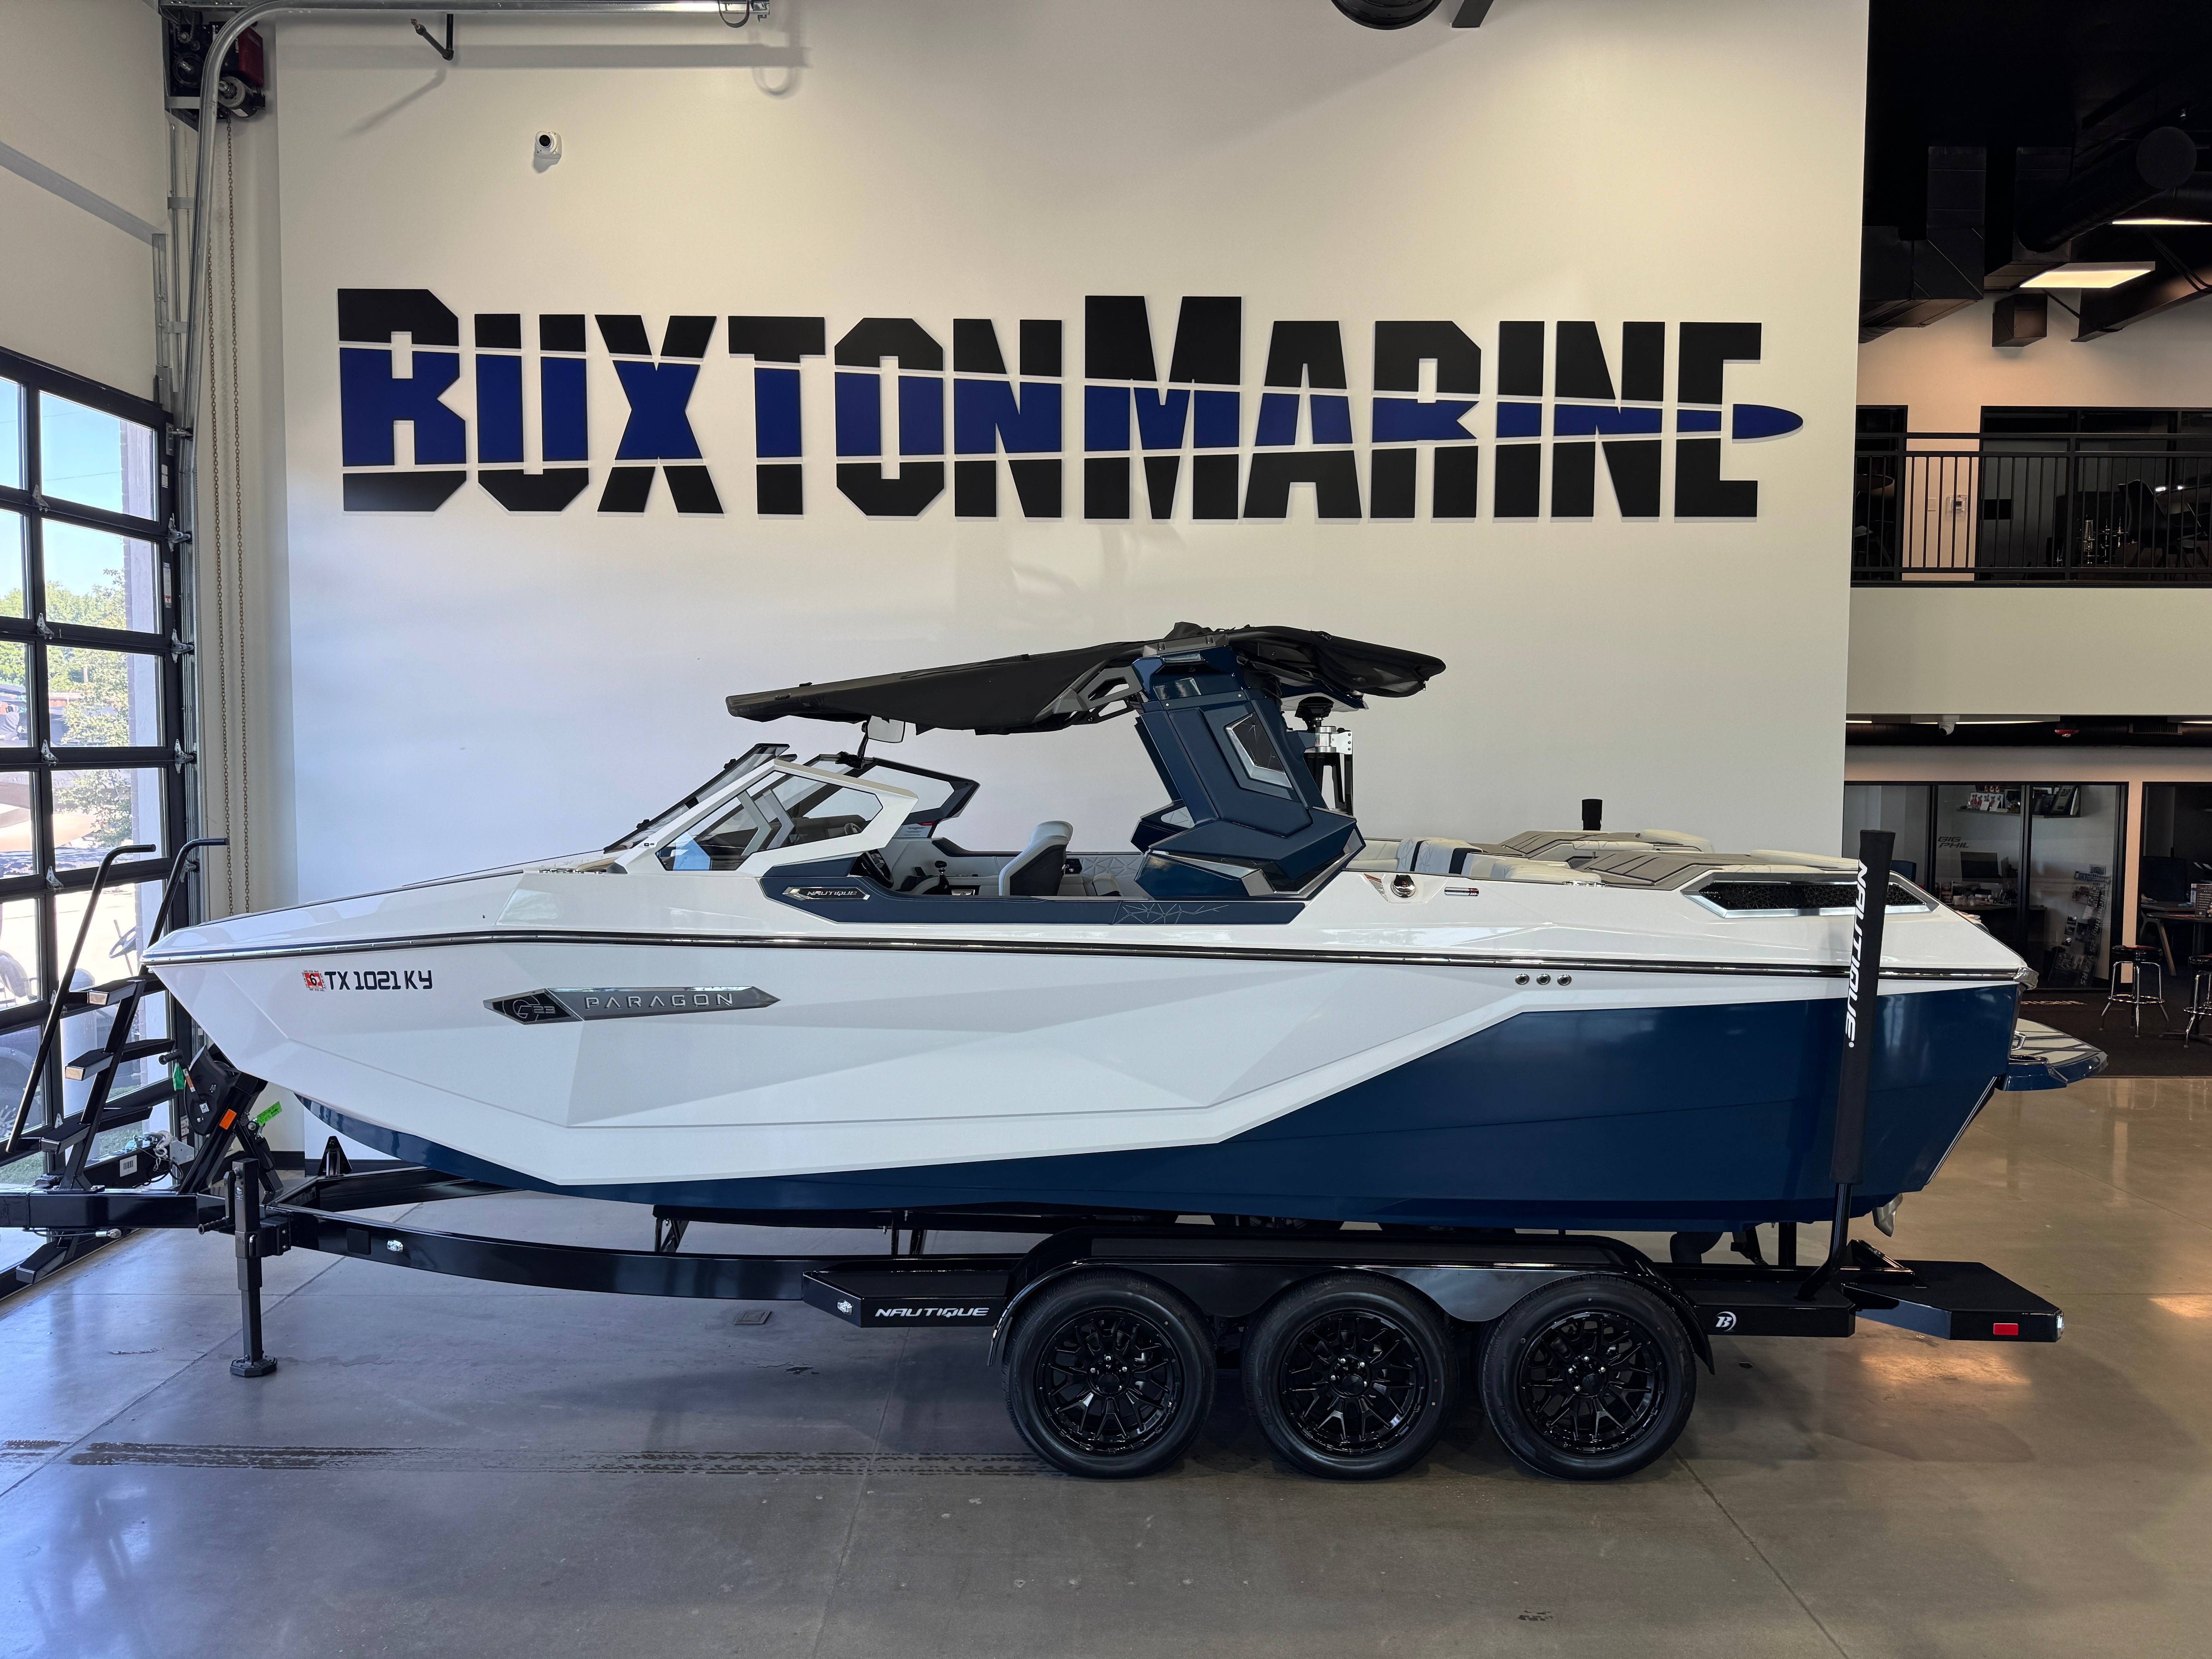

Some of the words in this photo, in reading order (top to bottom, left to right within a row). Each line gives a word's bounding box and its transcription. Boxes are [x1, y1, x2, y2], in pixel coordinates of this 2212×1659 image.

[309, 973, 317, 986] 6
[324, 971, 350, 990] TX
[353, 971, 401, 990] 1021
[404, 970, 433, 989] KY
[585, 993, 734, 1010] PARAGON
[875, 1308, 989, 1318] NAUTIQUE
